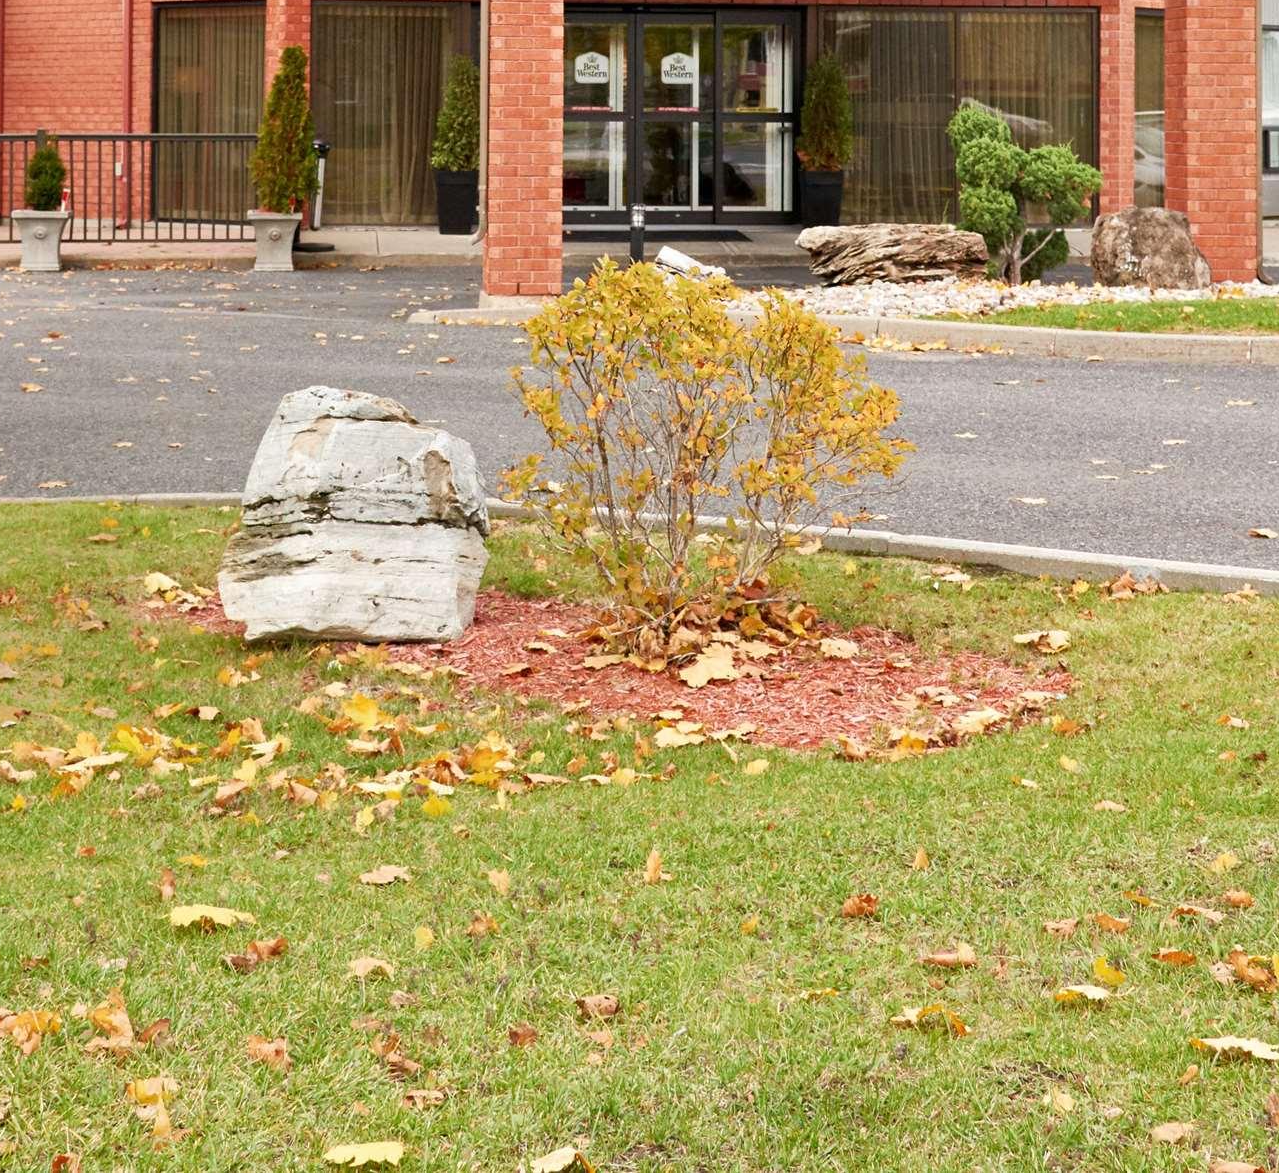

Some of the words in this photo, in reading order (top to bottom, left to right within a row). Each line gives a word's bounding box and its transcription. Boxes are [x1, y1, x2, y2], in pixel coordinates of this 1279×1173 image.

[583, 62, 600, 71] Best
[669, 63, 686, 72] Best
[577, 70, 607, 78] Western
[663, 71, 693, 79] Western
